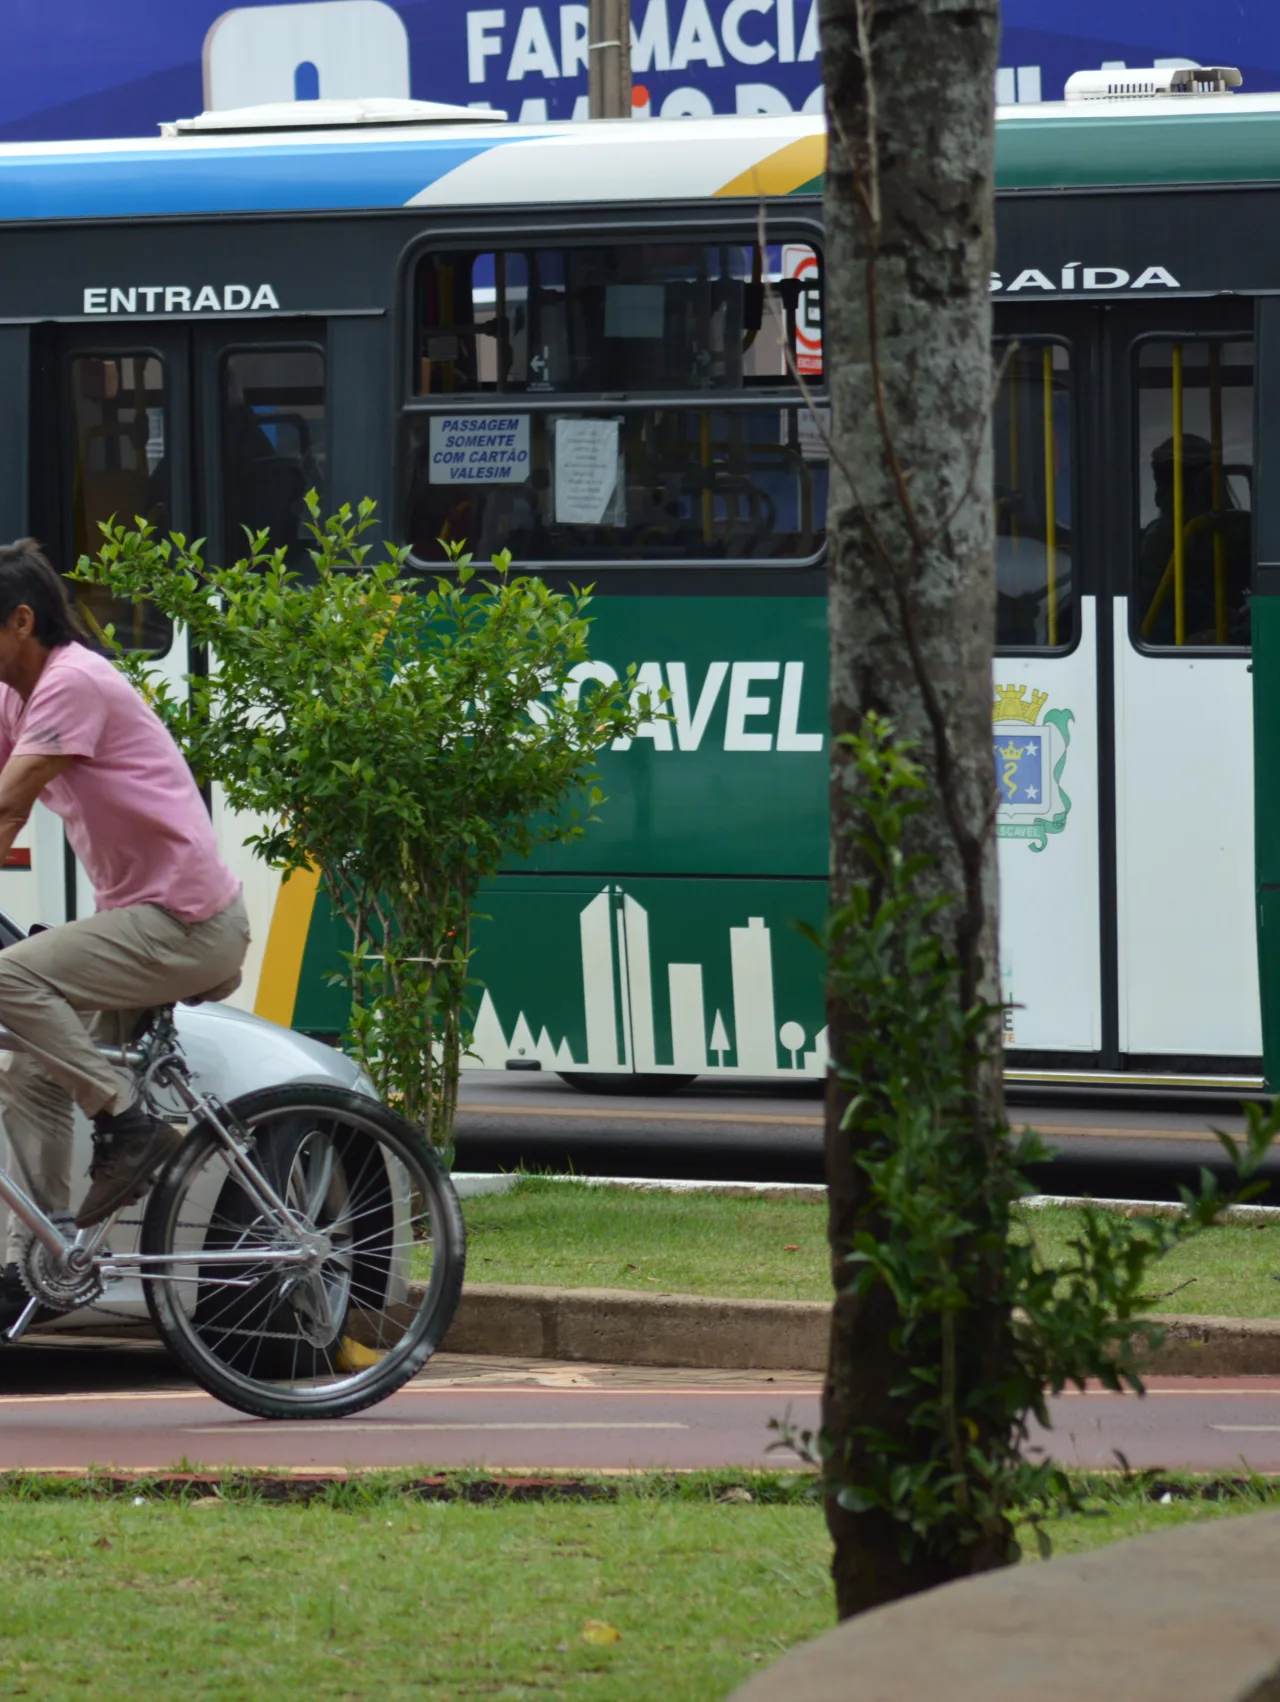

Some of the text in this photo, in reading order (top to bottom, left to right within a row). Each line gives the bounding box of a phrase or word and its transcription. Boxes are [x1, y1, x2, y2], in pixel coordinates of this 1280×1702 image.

[84, 284, 280, 313] ENTRADA
[442, 418, 520, 432] PASSAGEM
[445, 434, 516, 448] SOMENTE
[433, 448, 528, 464] COM CARTÃO
[450, 466, 512, 480] VALESIM
[998, 826, 1041, 838] SCAVEL
